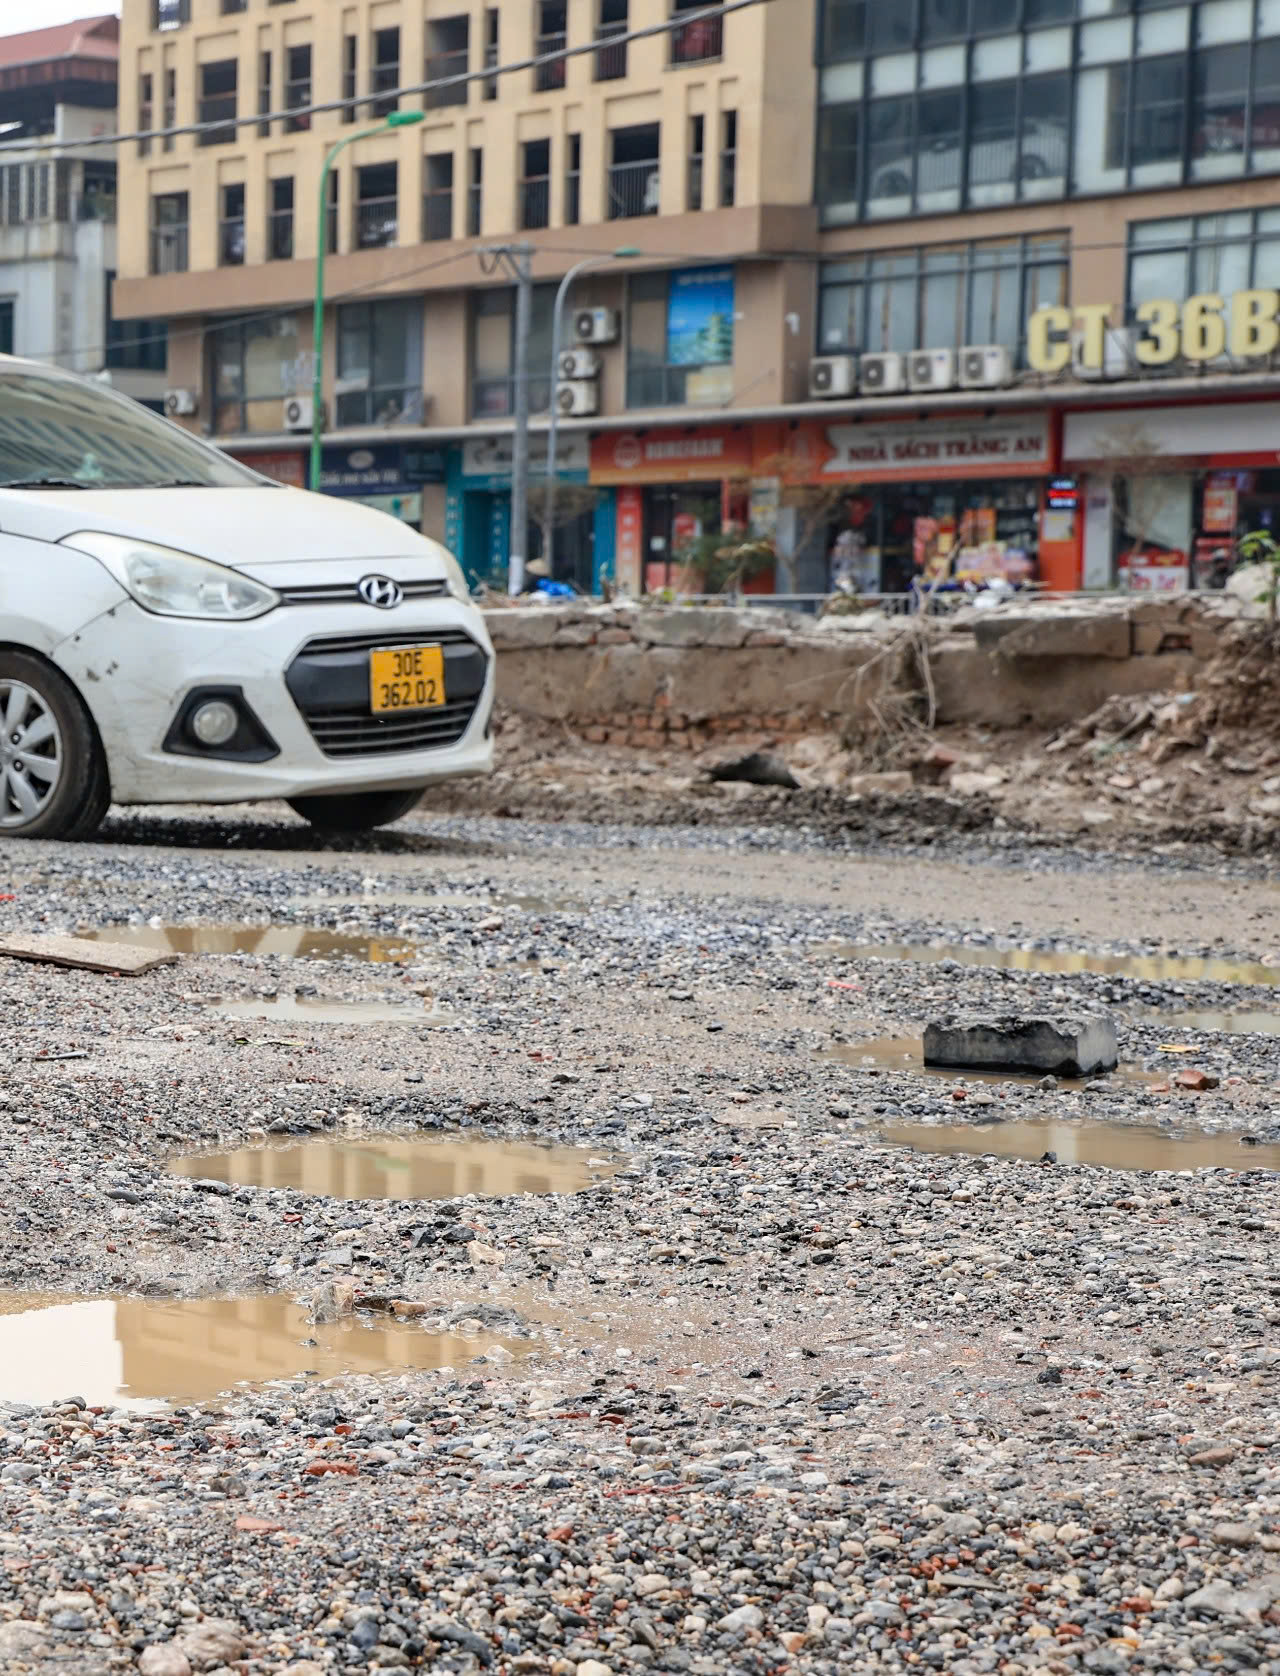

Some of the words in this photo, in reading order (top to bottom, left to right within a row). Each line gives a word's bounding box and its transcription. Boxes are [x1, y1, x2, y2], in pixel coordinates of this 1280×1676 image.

[1027, 304, 1113, 372] CT
[1134, 289, 1280, 365] 36B
[848, 438, 886, 461] NHÀ
[892, 436, 939, 459] SÁCH
[392, 651, 423, 677] 30E
[380, 679, 437, 708] 362.02
